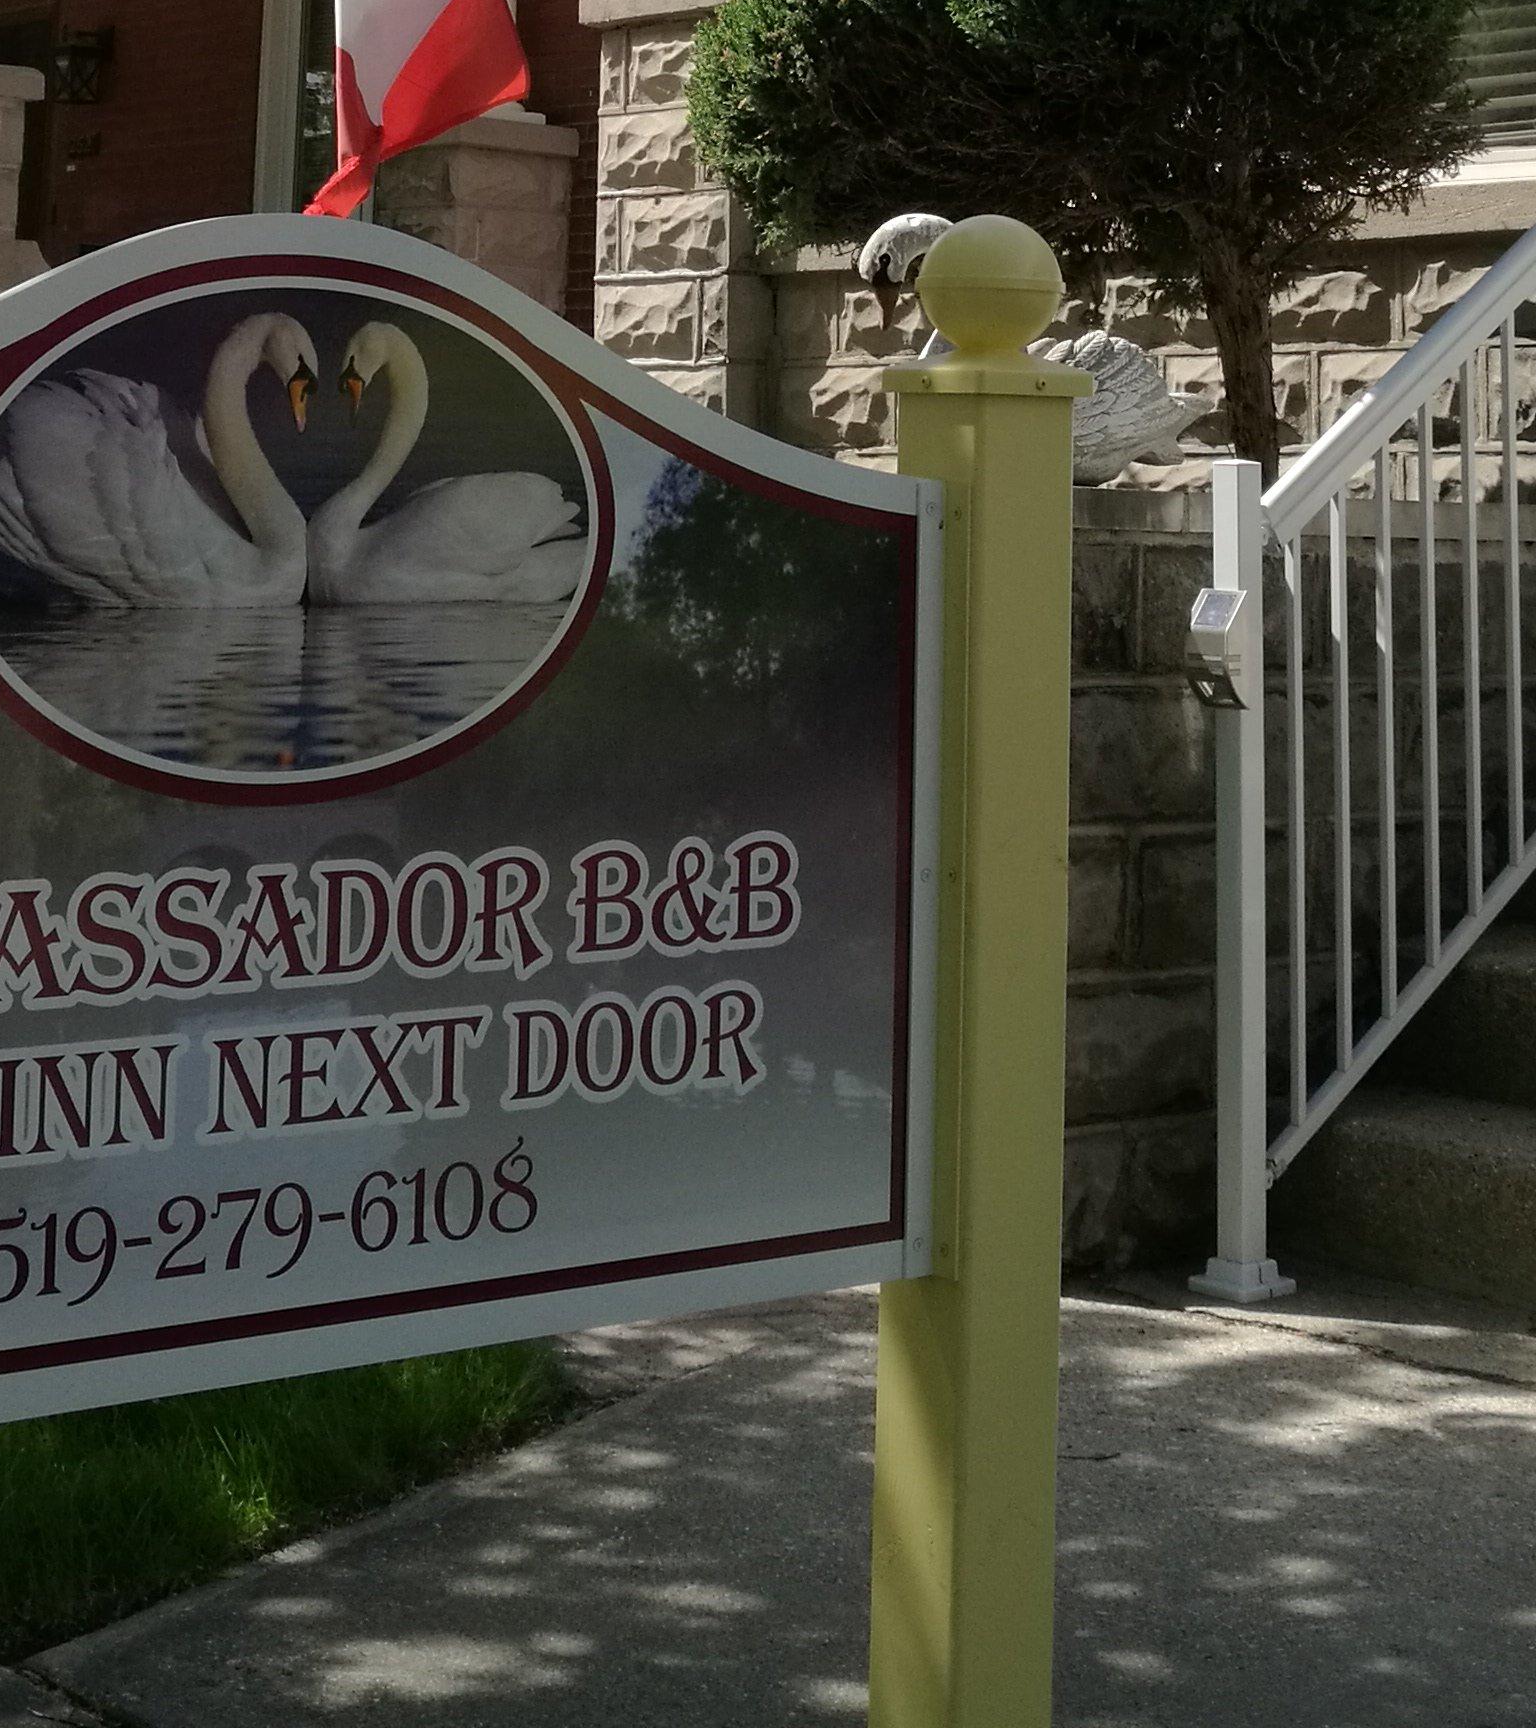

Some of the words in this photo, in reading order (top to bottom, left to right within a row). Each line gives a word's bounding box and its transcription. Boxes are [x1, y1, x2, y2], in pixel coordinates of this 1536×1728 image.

[572, 839, 796, 954] B&B
[205, 1014, 484, 1134] NEXT
[506, 988, 759, 1102] DOOR
